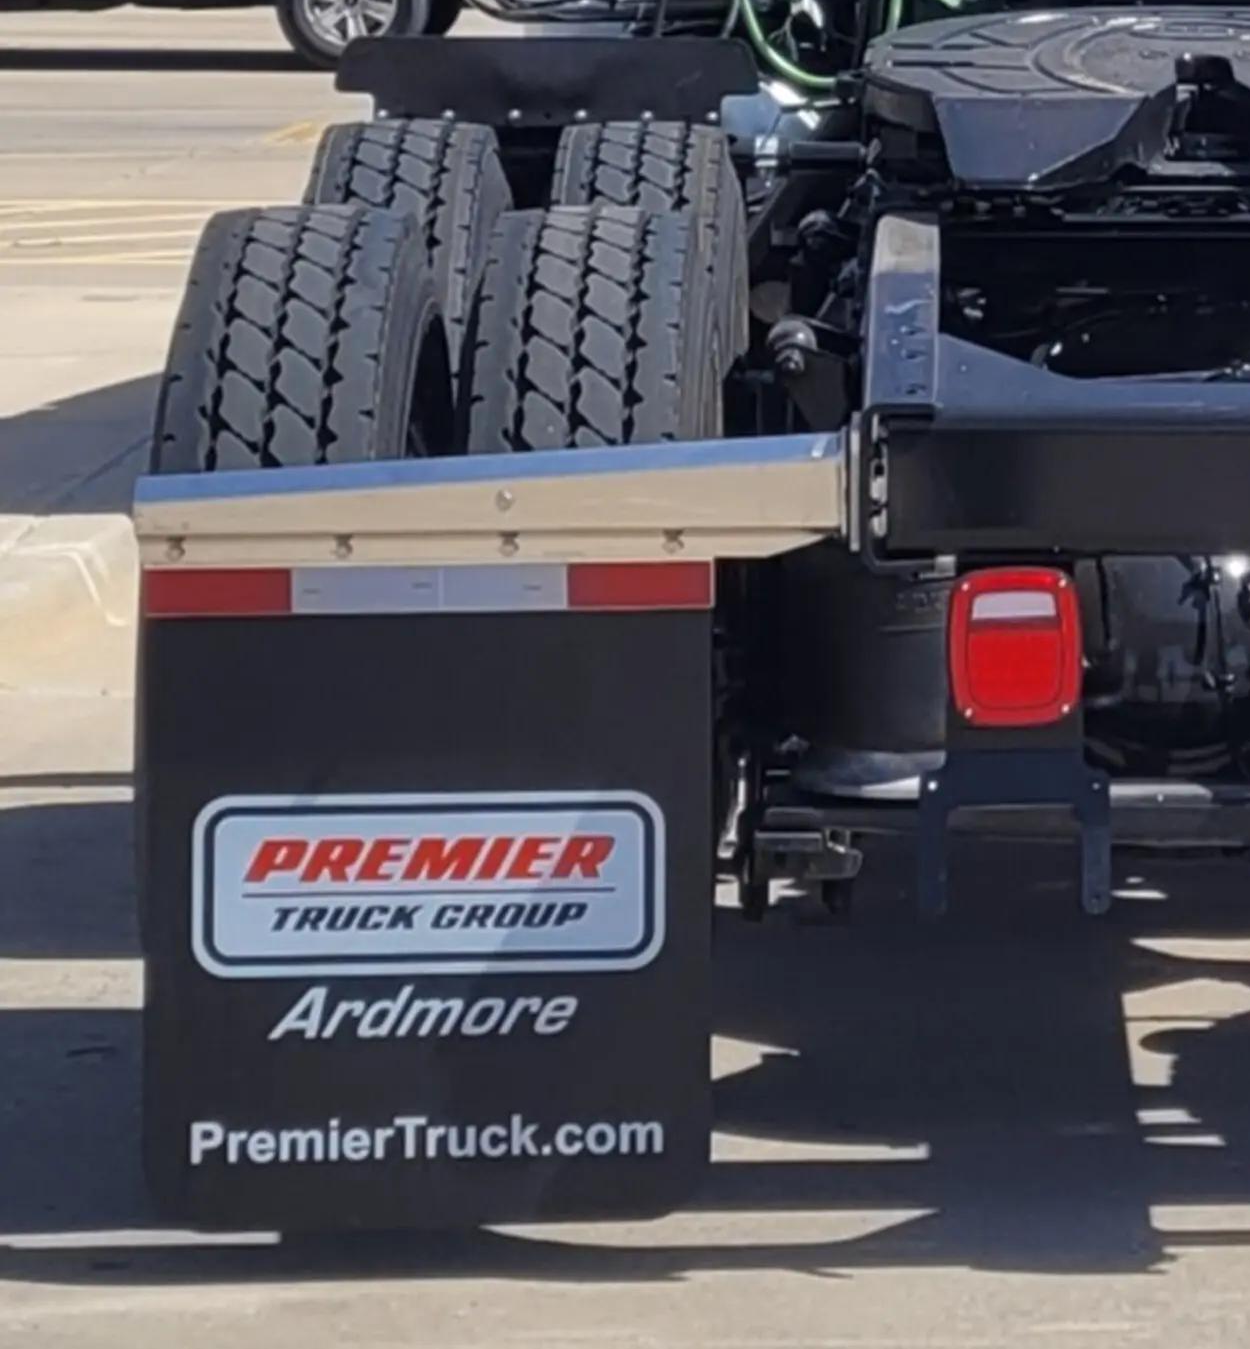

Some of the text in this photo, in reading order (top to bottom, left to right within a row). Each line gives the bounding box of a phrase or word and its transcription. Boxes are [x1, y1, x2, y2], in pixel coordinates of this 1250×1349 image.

[243, 834, 616, 883] PREMIER
[271, 901, 589, 932] TRUCK GROUP
[266, 984, 579, 1041] Ardmore
[189, 1115, 664, 1166] PremierTruck.com
